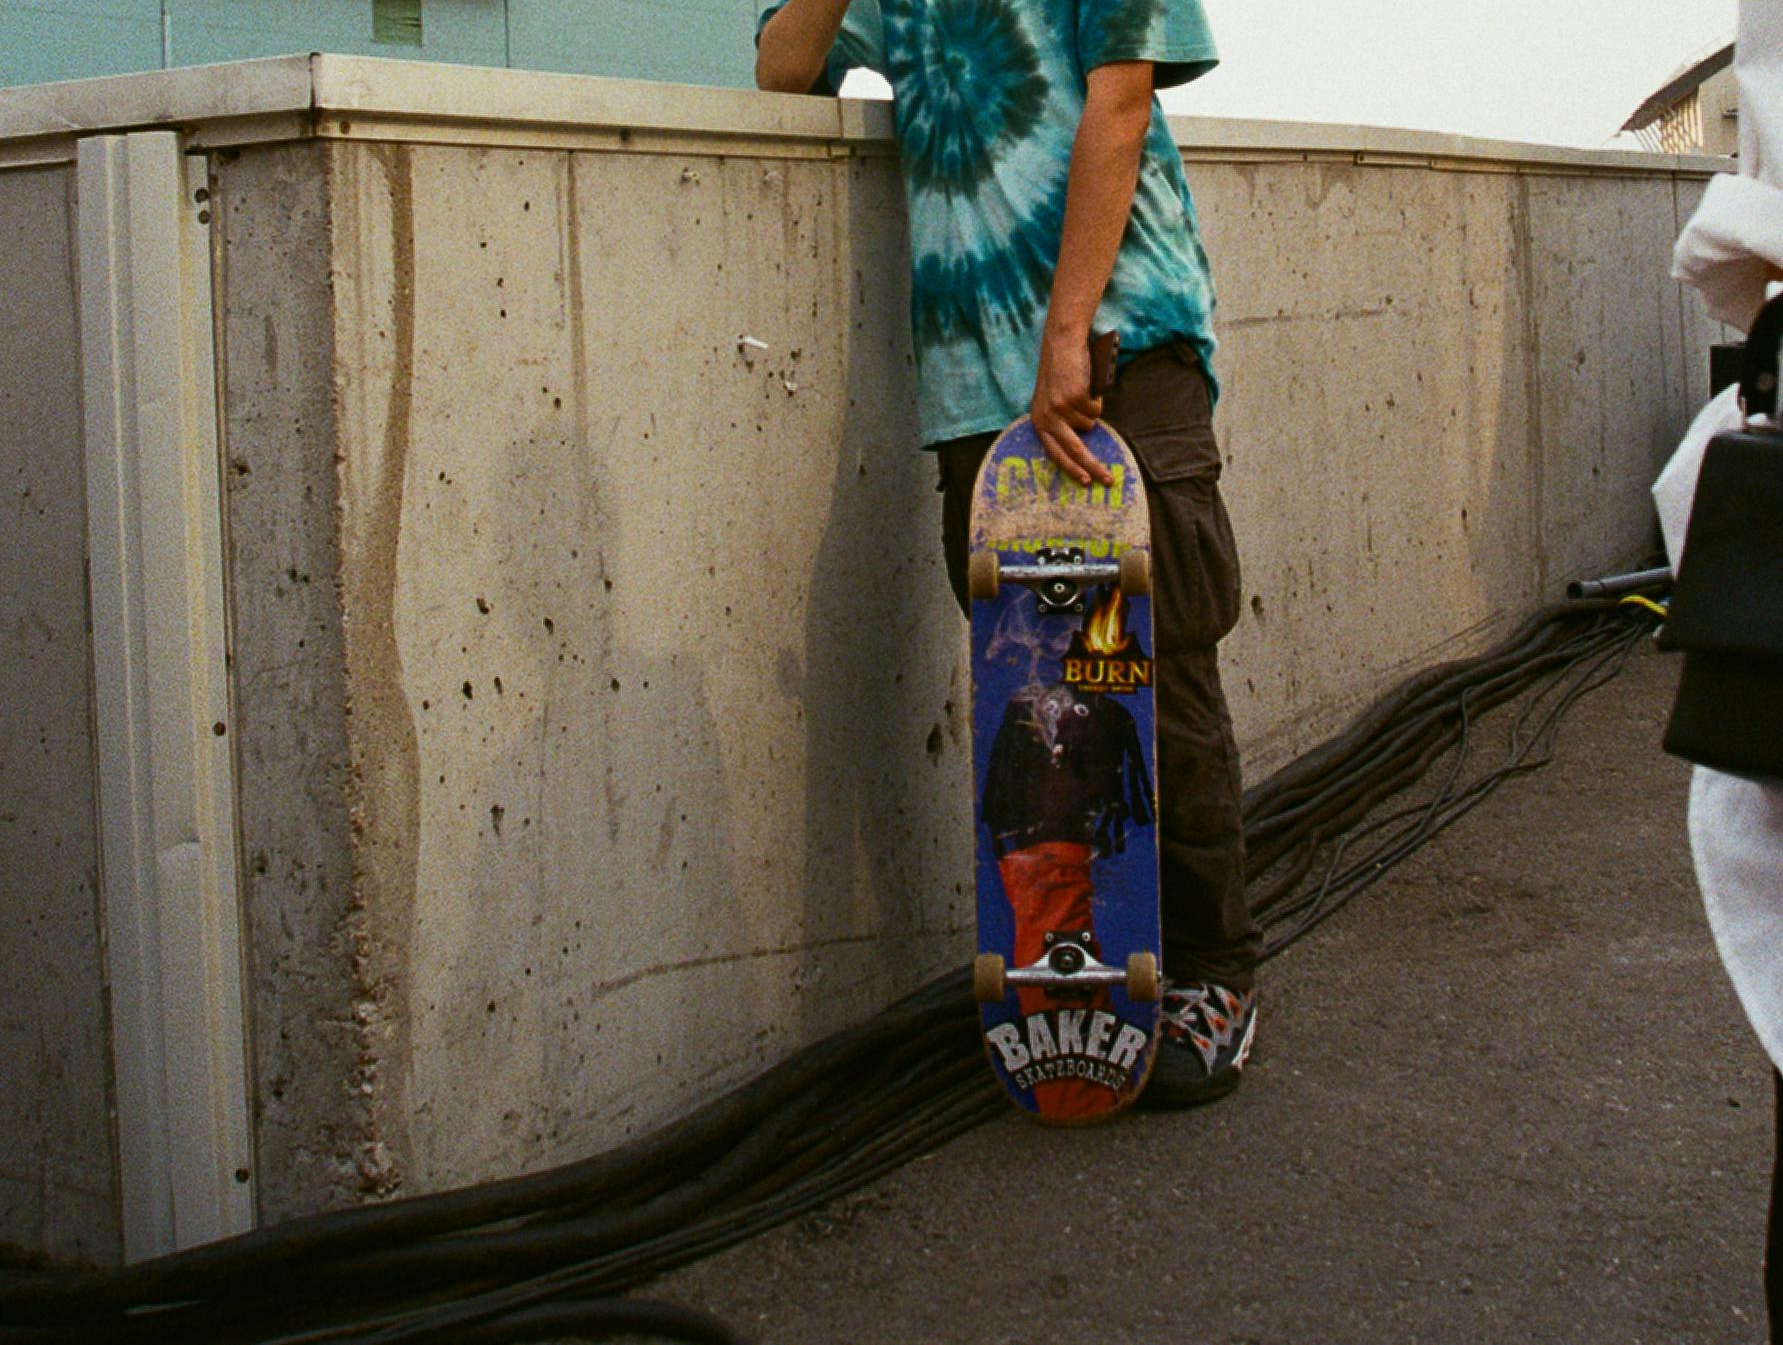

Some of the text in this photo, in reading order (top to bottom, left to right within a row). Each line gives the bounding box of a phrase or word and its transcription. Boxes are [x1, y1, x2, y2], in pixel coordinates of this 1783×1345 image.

[1064, 658, 1150, 685] BURN
[986, 1009, 1147, 1073] BAKER
[1014, 1057, 1126, 1090] SKATEBOARDS
